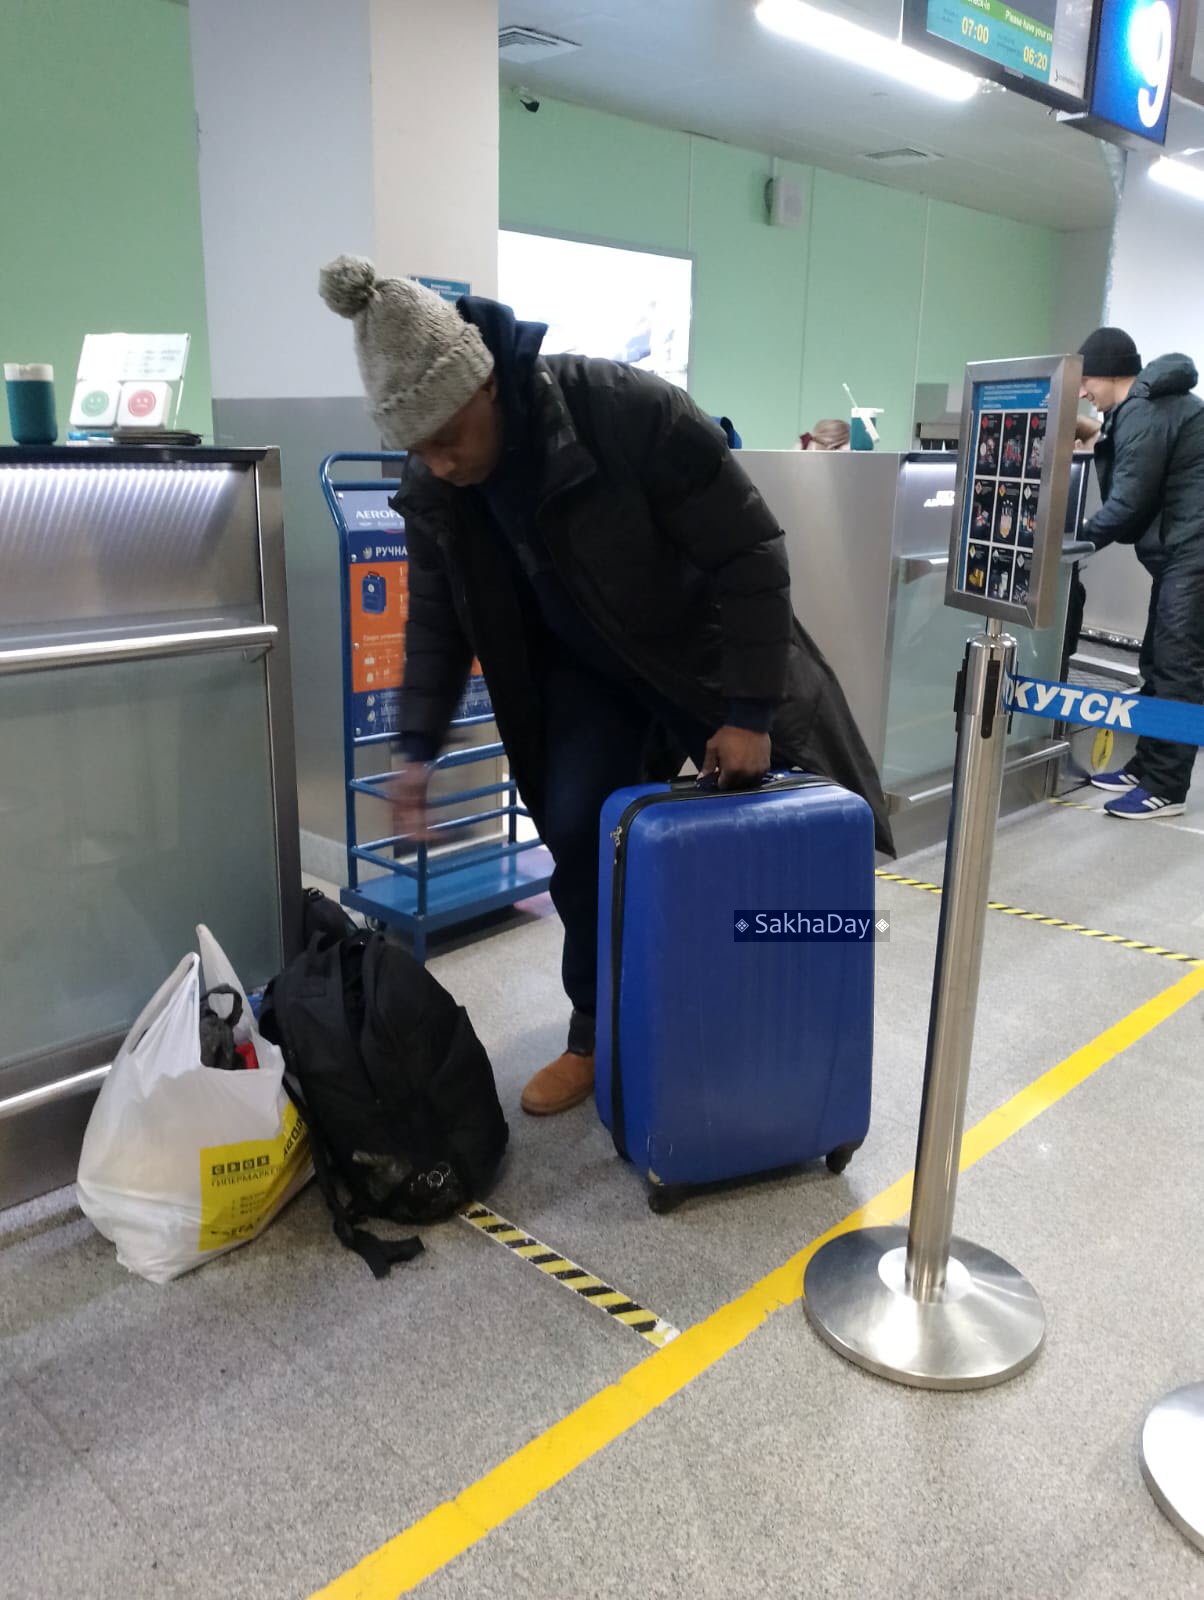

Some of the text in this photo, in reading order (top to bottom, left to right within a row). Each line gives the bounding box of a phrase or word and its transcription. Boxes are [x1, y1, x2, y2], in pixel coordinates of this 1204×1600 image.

[961, 17, 989, 44] 07:00
[1005, 10, 1022, 27] Please
[1023, 19, 1035, 33] have
[1035, 27, 1047, 39] your
[1023, 46, 1048, 71] 06:20
[1130, 1, 1171, 128] 9
[375, 545, 408, 557] РУЧНА
